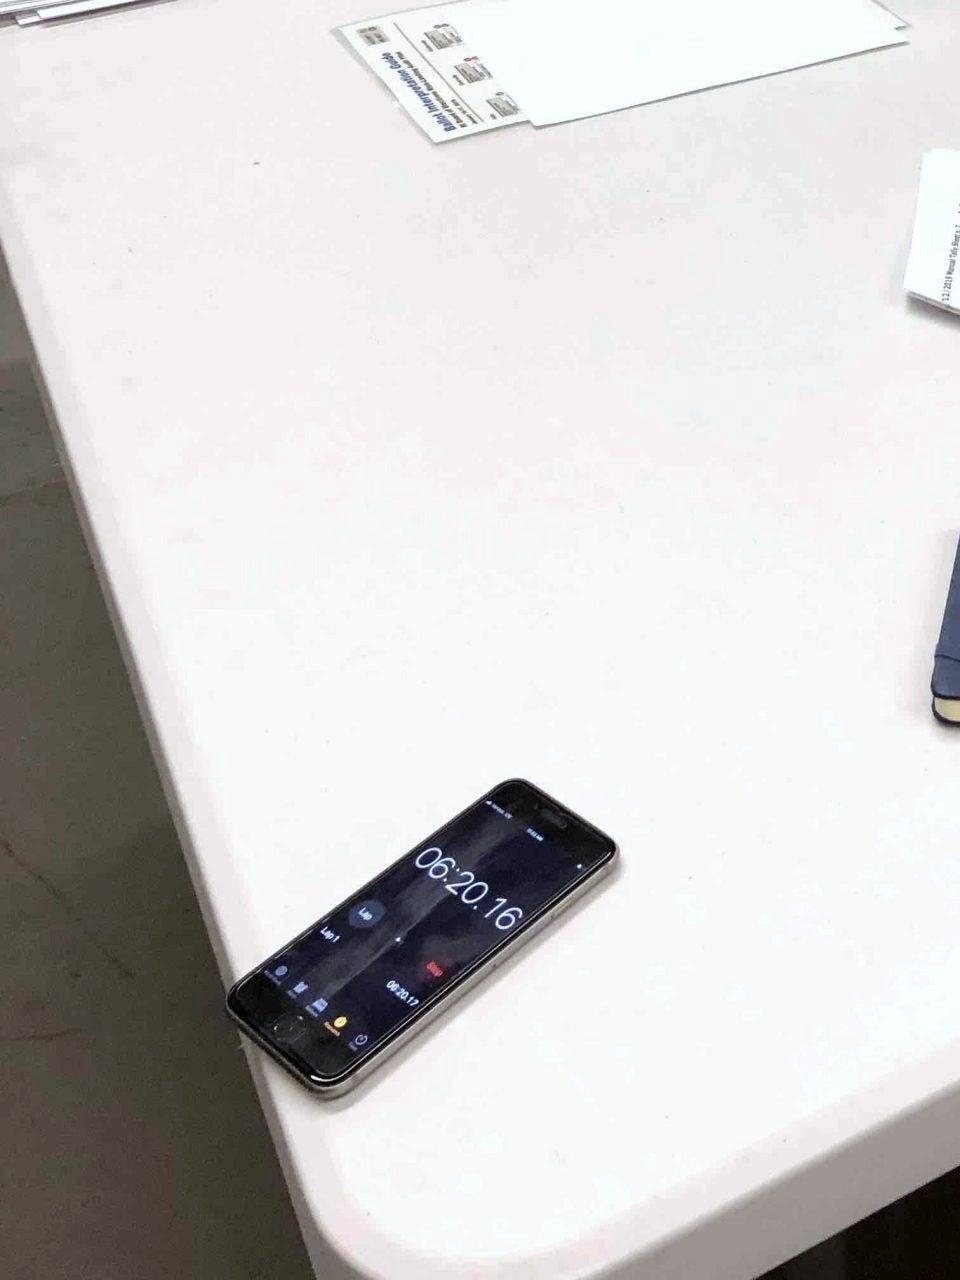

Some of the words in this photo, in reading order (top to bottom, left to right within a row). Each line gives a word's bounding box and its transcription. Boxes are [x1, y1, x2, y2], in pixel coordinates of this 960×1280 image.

[381, 52, 402, 70] Guide
[397, 69, 440, 114] Interpretation
[432, 112, 457, 132] Ballot
[415, 847, 523, 930] 06:20.16
[358, 907, 373, 921] Lap
[320, 926, 335, 940] Lap
[426, 961, 444, 977] Stop
